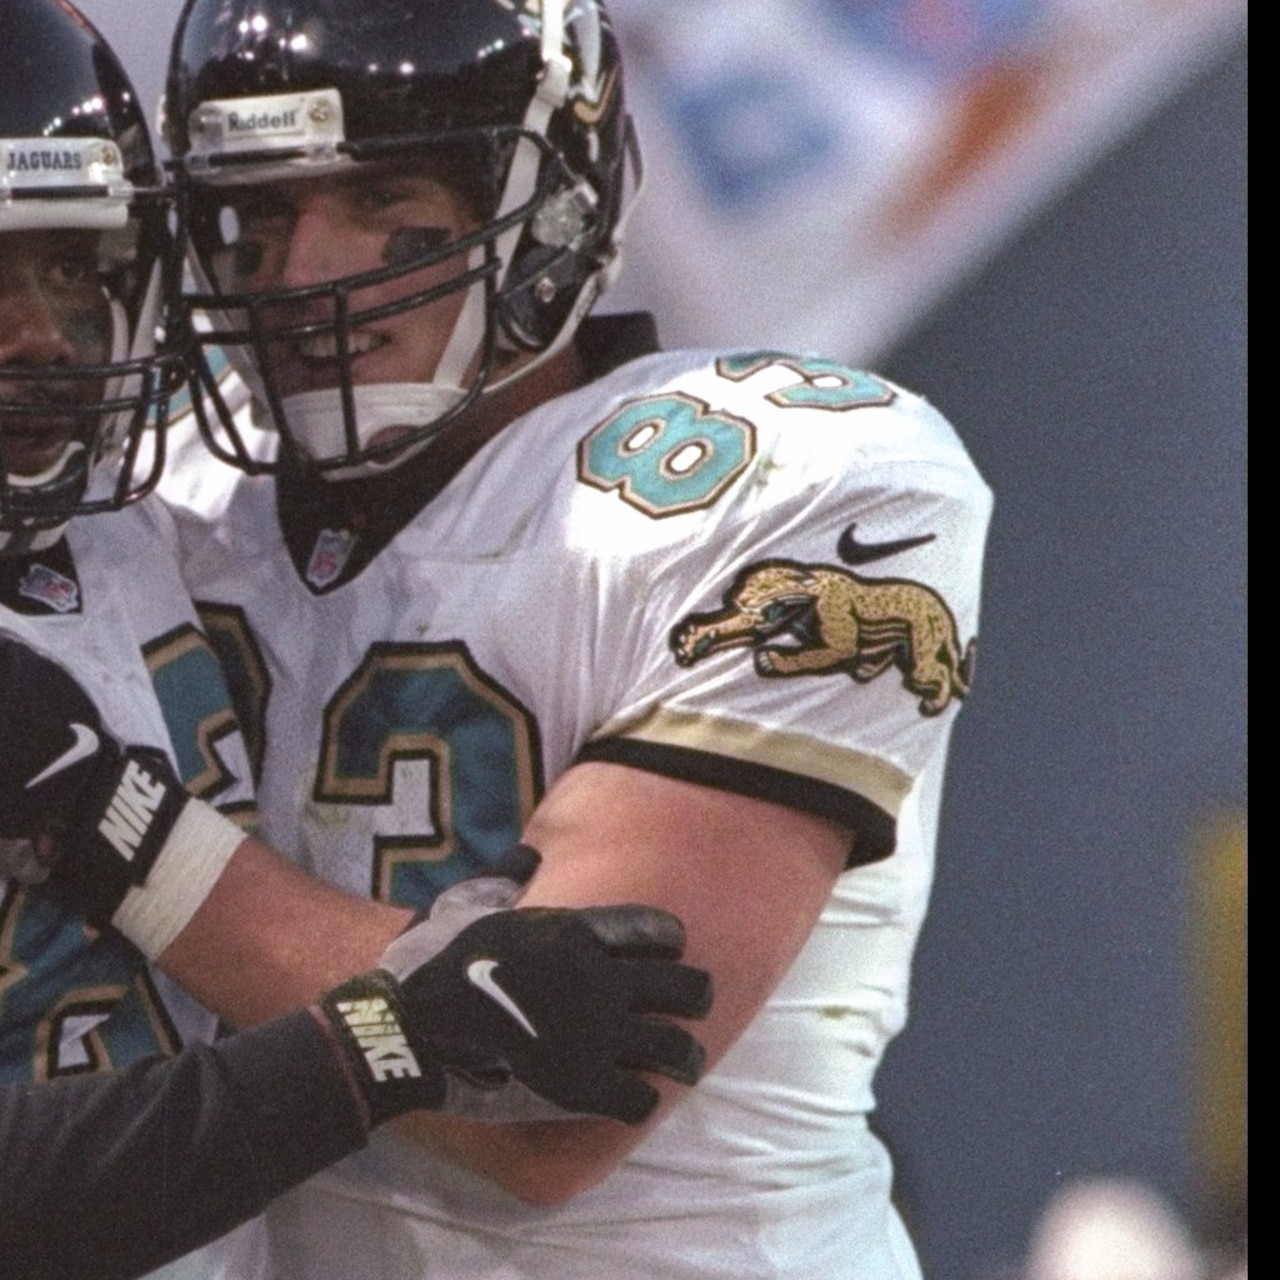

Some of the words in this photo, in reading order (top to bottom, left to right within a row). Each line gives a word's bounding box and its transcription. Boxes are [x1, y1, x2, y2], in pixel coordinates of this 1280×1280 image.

[7, 150, 82, 170] JAGUARS
[97, 758, 167, 862] NIKE
[335, 993, 423, 1083] NIKE
